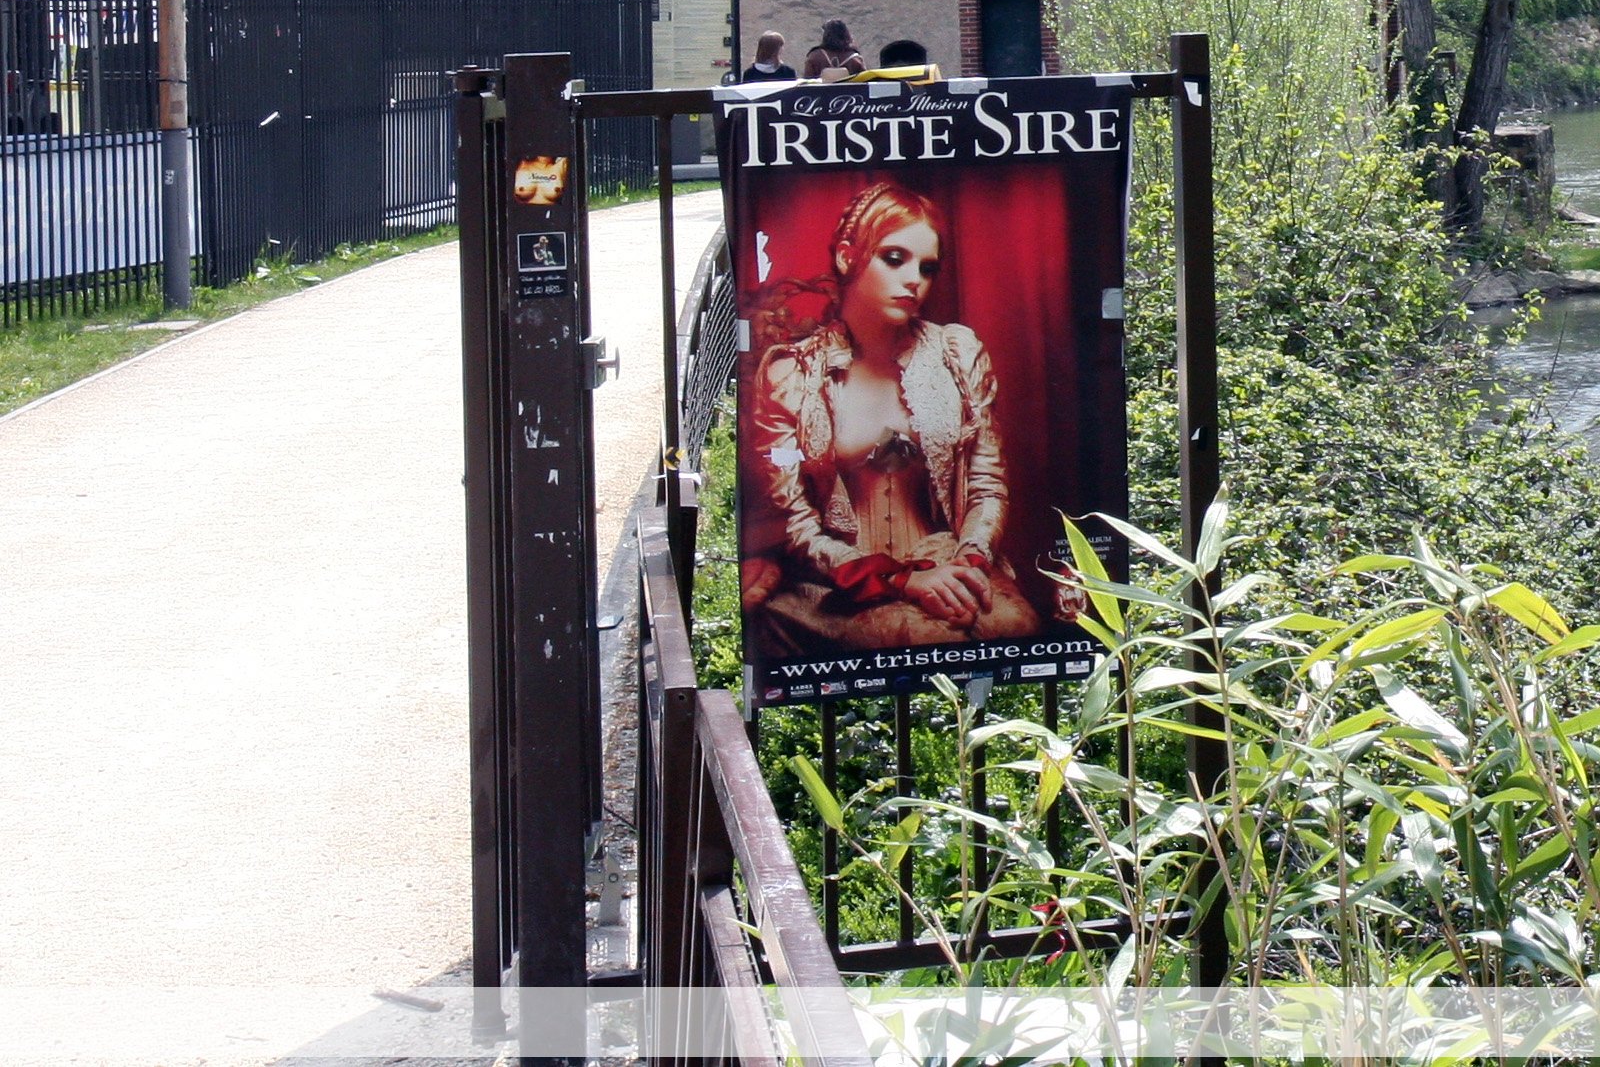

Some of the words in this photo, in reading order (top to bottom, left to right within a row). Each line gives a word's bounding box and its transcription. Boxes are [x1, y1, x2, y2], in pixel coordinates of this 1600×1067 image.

[724, 99, 956, 167] TRISTE
[974, 91, 1121, 157] SIRE
[792, 95, 824, 117] Le
[828, 93, 894, 116] Prince
[898, 92, 972, 113] Illusion
